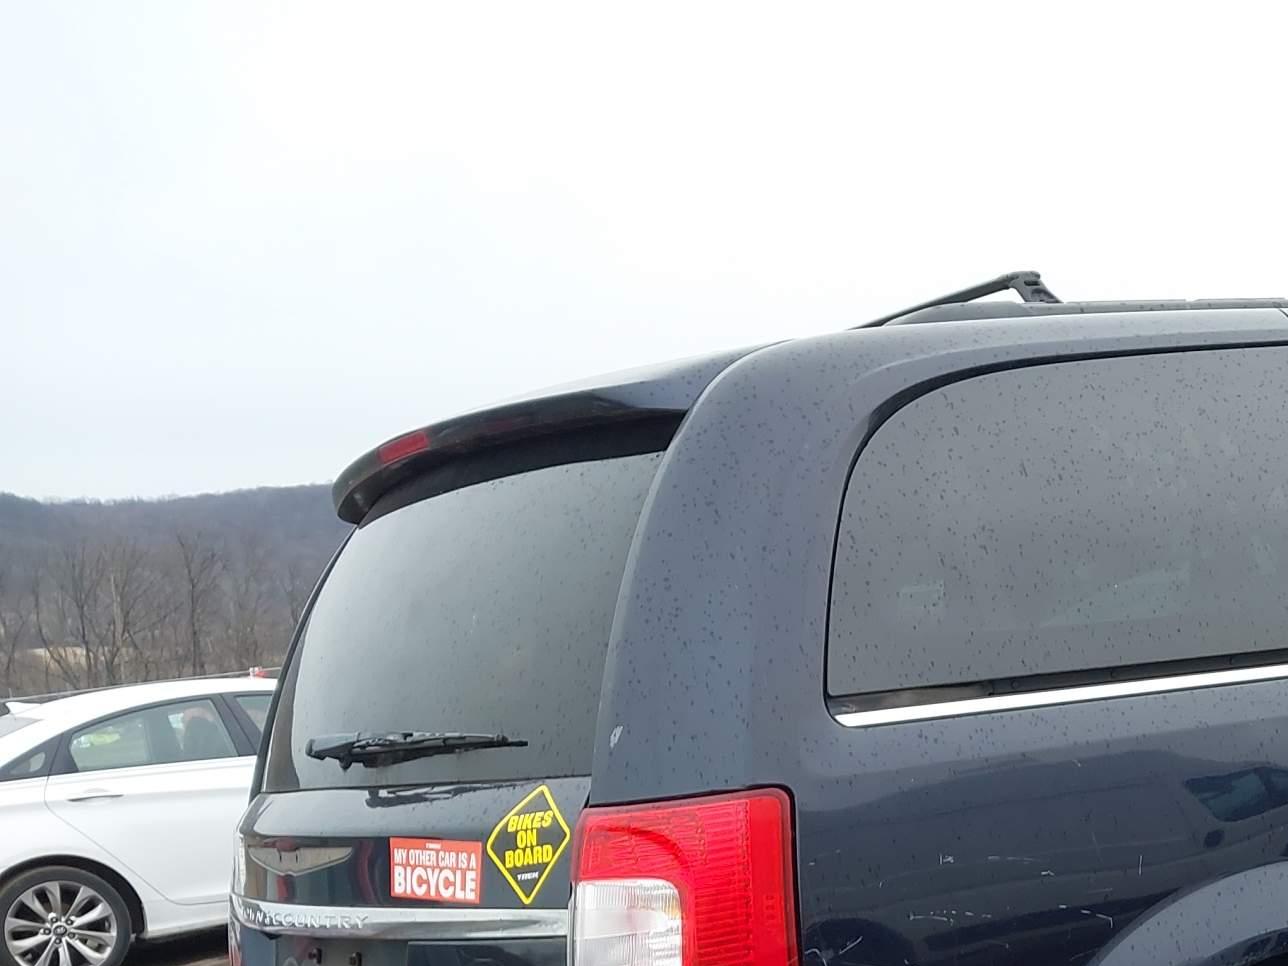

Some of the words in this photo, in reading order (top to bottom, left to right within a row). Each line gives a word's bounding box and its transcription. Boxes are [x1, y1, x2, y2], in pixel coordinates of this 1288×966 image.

[507, 810, 554, 832] BIKES
[517, 828, 537, 848] ON
[394, 848, 407, 864] MY
[409, 849, 437, 867] OTHER
[439, 850, 457, 868] CAR
[458, 852, 468, 868] IS
[469, 853, 476, 869] A
[505, 845, 553, 868] BOARD
[394, 865, 476, 900] BICYCLE
